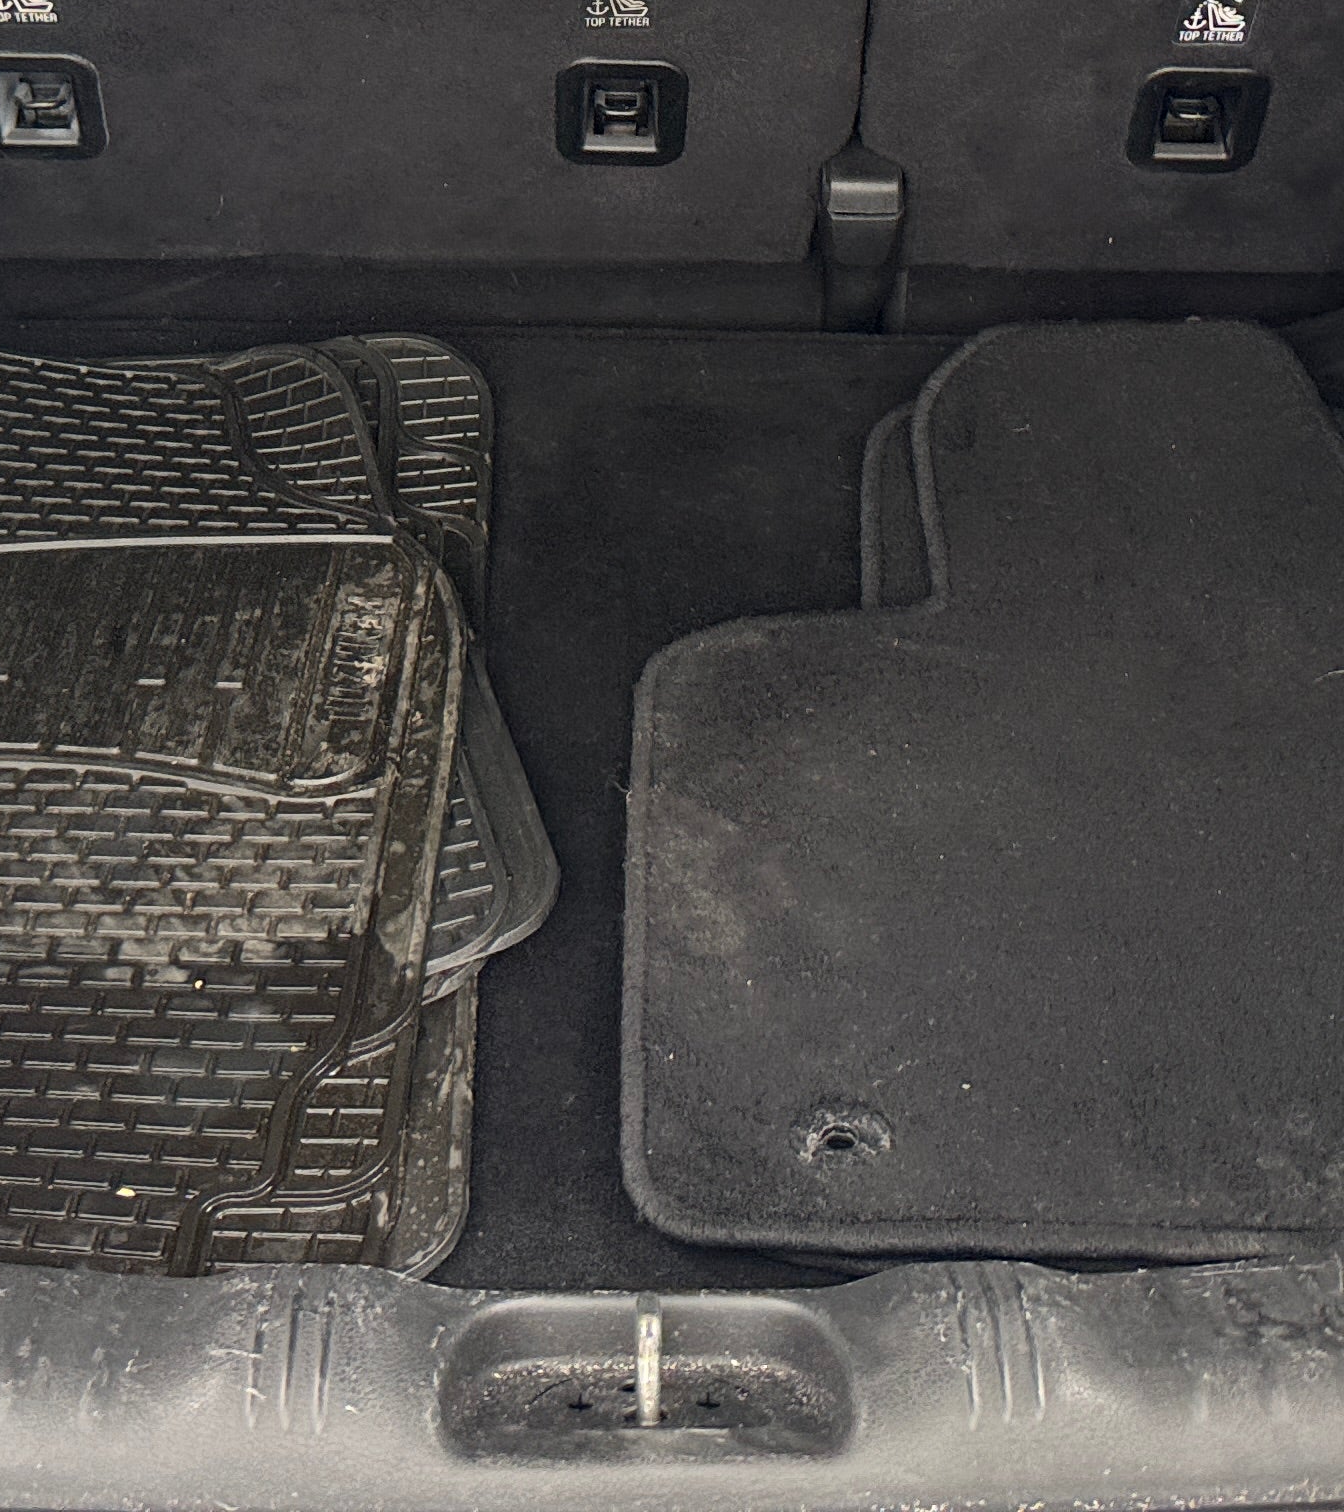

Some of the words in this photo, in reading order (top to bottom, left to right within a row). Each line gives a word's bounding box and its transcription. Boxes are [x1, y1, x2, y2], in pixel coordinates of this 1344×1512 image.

[14, 12, 58, 23] TETHER
[584, 17, 606, 27] TOP
[609, 17, 650, 27] TETHER
[1178, 30, 1200, 41] TOP
[1203, 30, 1244, 42] TETHER
